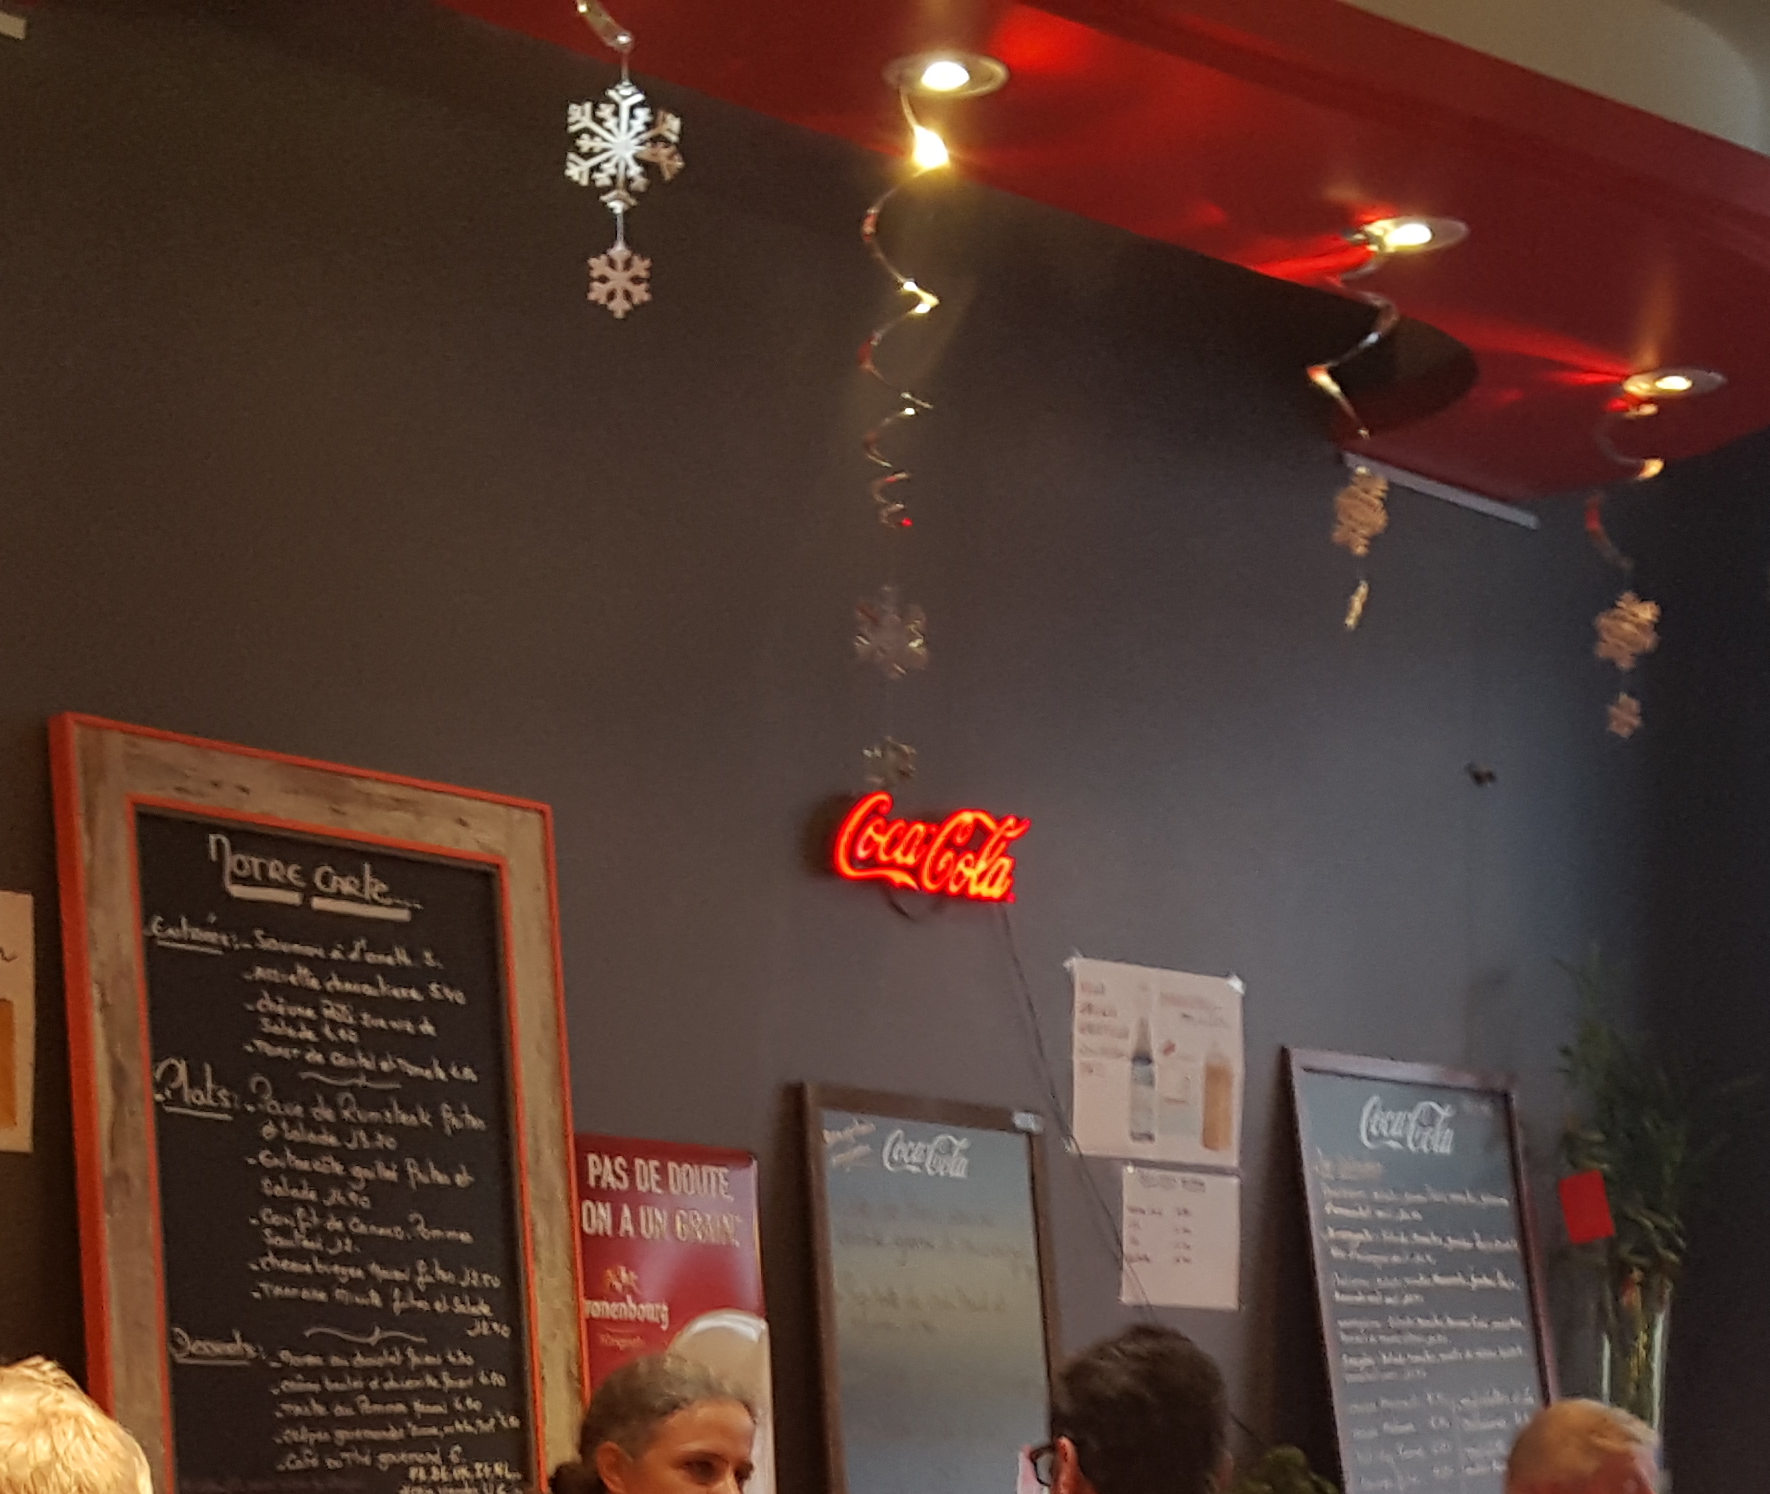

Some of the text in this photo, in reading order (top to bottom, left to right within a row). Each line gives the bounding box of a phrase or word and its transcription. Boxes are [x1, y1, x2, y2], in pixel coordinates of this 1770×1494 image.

[834, 790, 1032, 903] Coca-Cola
[1360, 1096, 1456, 1155] Coca-Cola
[587, 1153, 630, 1191] PAS
[633, 1158, 664, 1195] DE
[883, 1129, 971, 1179] Coca-Cola
[581, 1199, 613, 1238] ON
[619, 1203, 635, 1238] A
[639, 1205, 669, 1241] UN
[584, 1294, 670, 1331] ronenbourg
